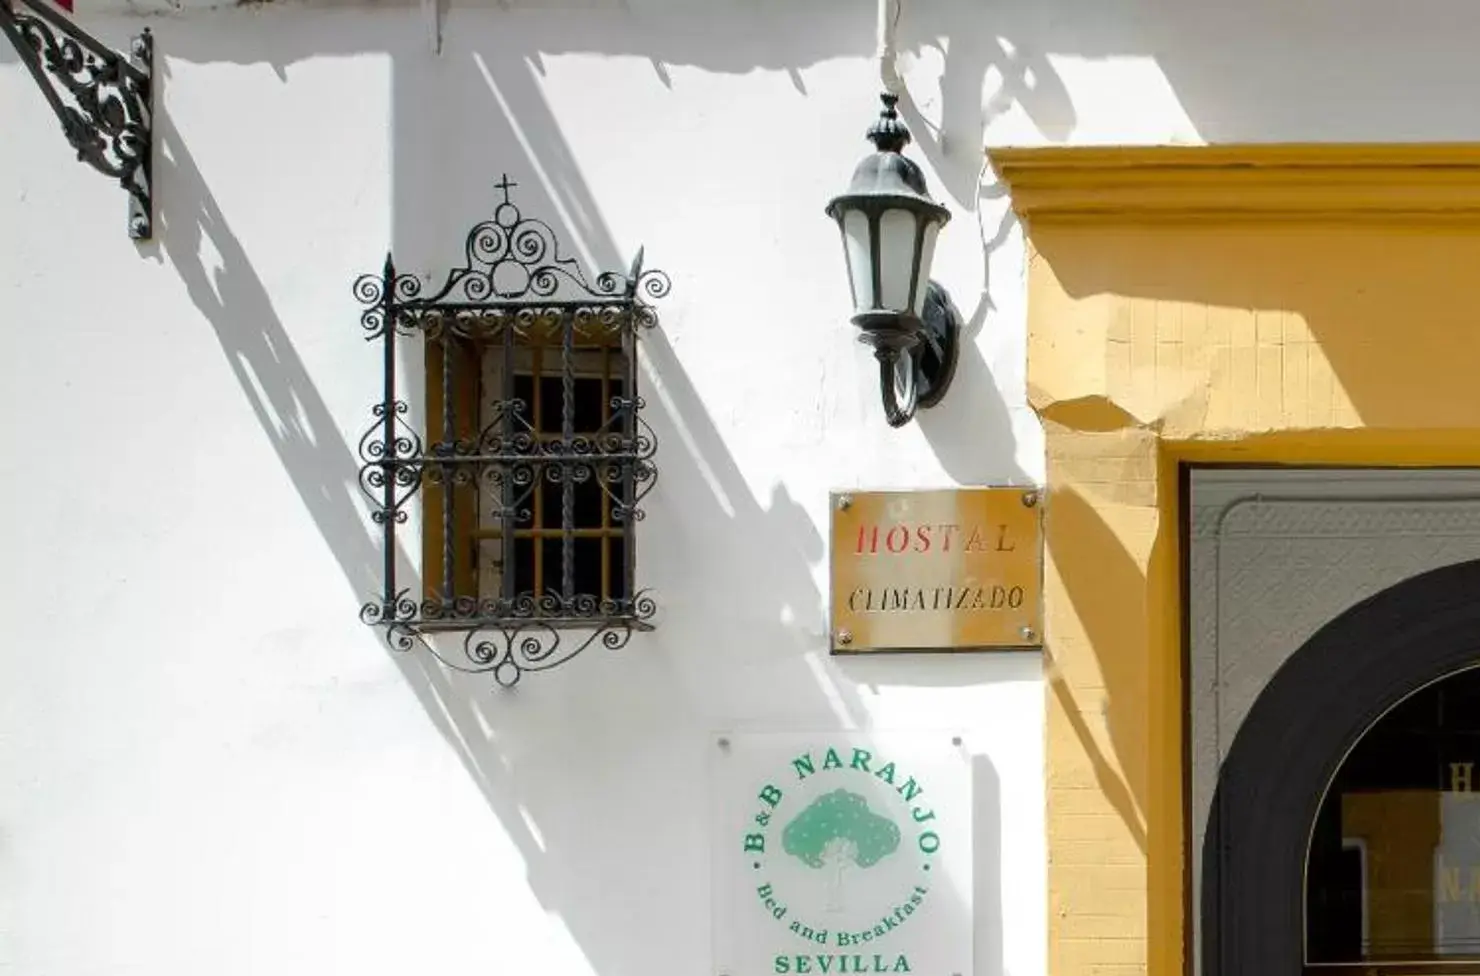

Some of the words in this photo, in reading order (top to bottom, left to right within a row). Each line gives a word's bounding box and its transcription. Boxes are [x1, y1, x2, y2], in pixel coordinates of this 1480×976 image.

[855, 522, 1015, 553] HOSTAL
[849, 585, 1024, 611] CLIMATIZADO
[744, 784, 783, 853] B&B
[792, 747, 941, 854] NARANJO
[757, 882, 787, 920] Bed
[790, 920, 828, 945] and
[837, 885, 927, 946] Breakfast
[774, 954, 911, 974] SEVILLA
